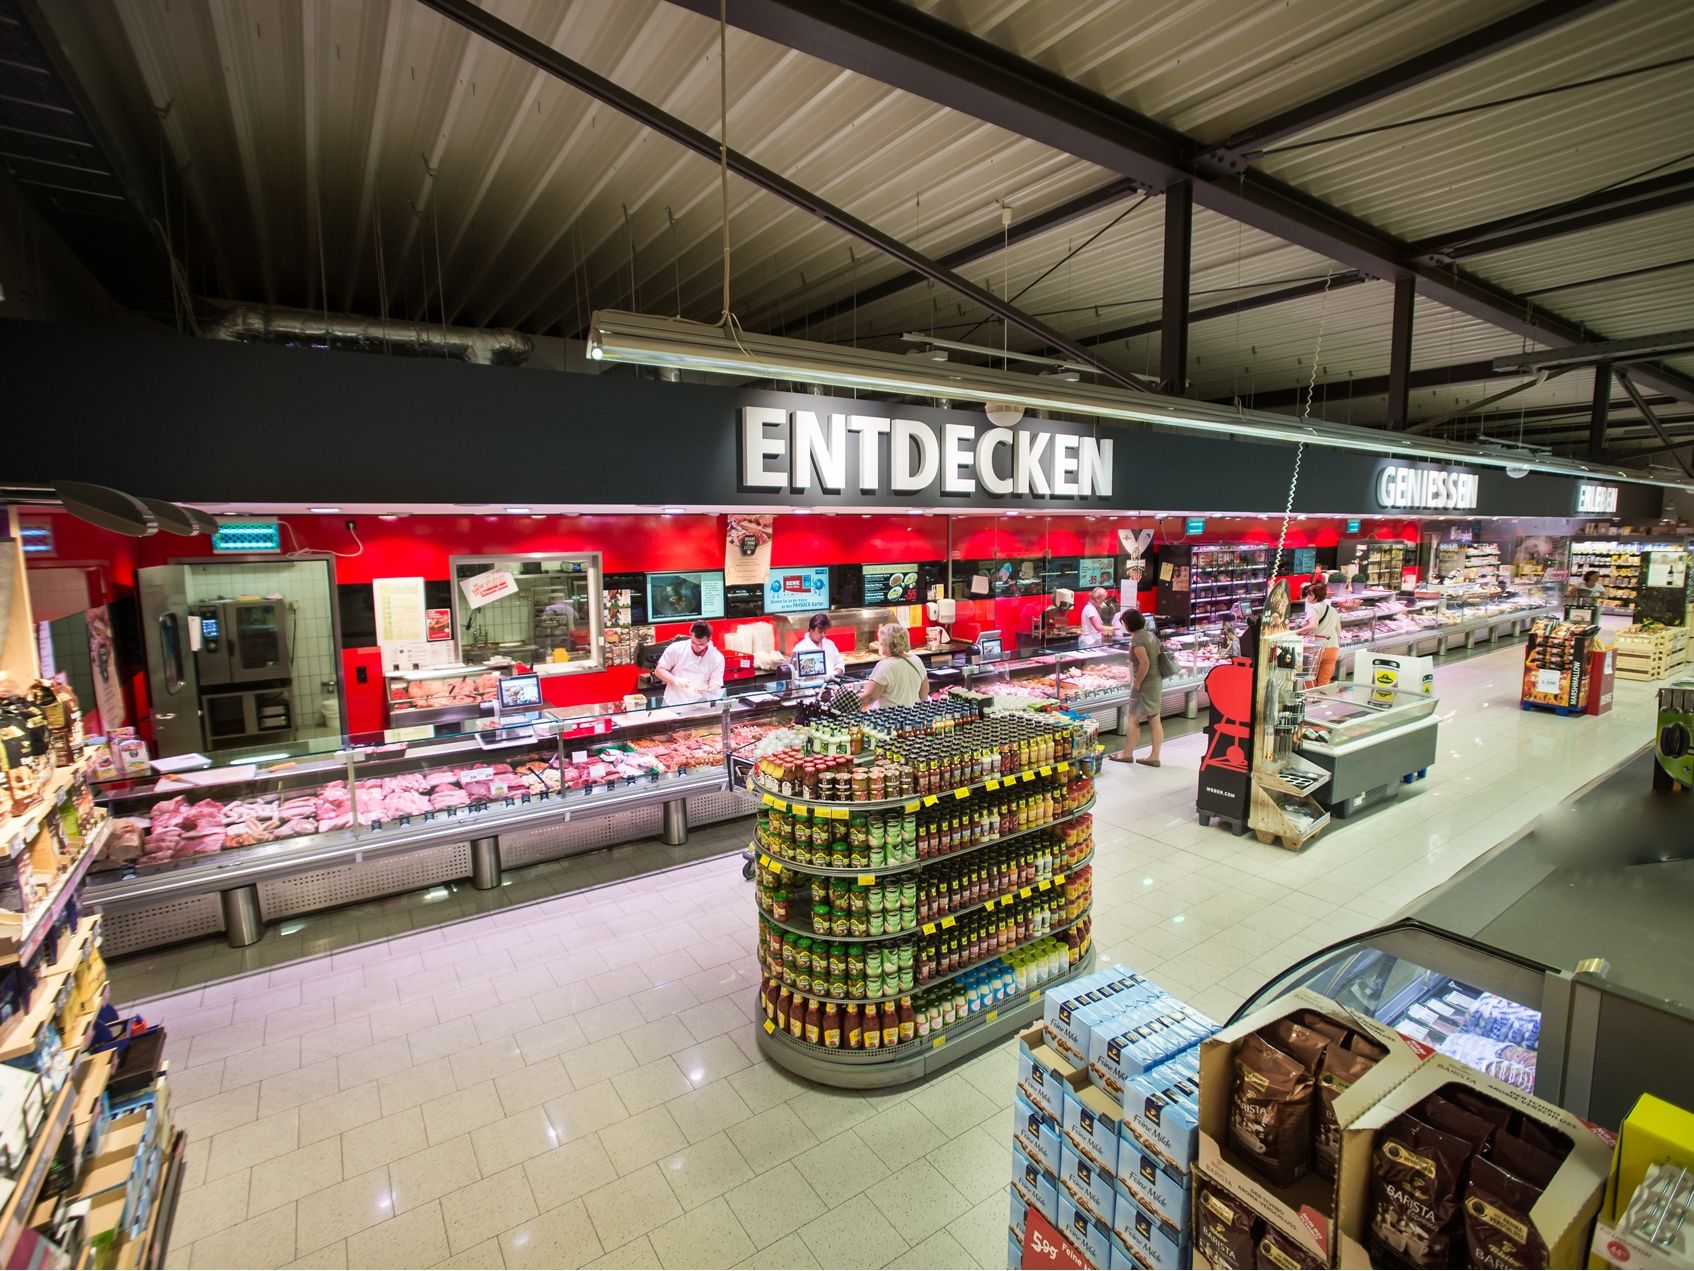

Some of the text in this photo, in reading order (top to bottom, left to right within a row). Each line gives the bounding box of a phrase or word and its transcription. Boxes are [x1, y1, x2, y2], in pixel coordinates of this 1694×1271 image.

[742, 406, 1113, 496] ENTDECKEN
[1379, 466, 1479, 508] GENIESSEN
[1570, 661, 1581, 705] MARSHMALLOW
[1206, 786, 1235, 798] WEBER.COM
[1437, 1063, 1477, 1085] BARISTA
[1386, 1184, 1435, 1222] BARISTA
[1407, 1208, 1439, 1232] Espresso
[1061, 1243, 1082, 1266] Feine
[1203, 1226, 1236, 1260] BARISTA
